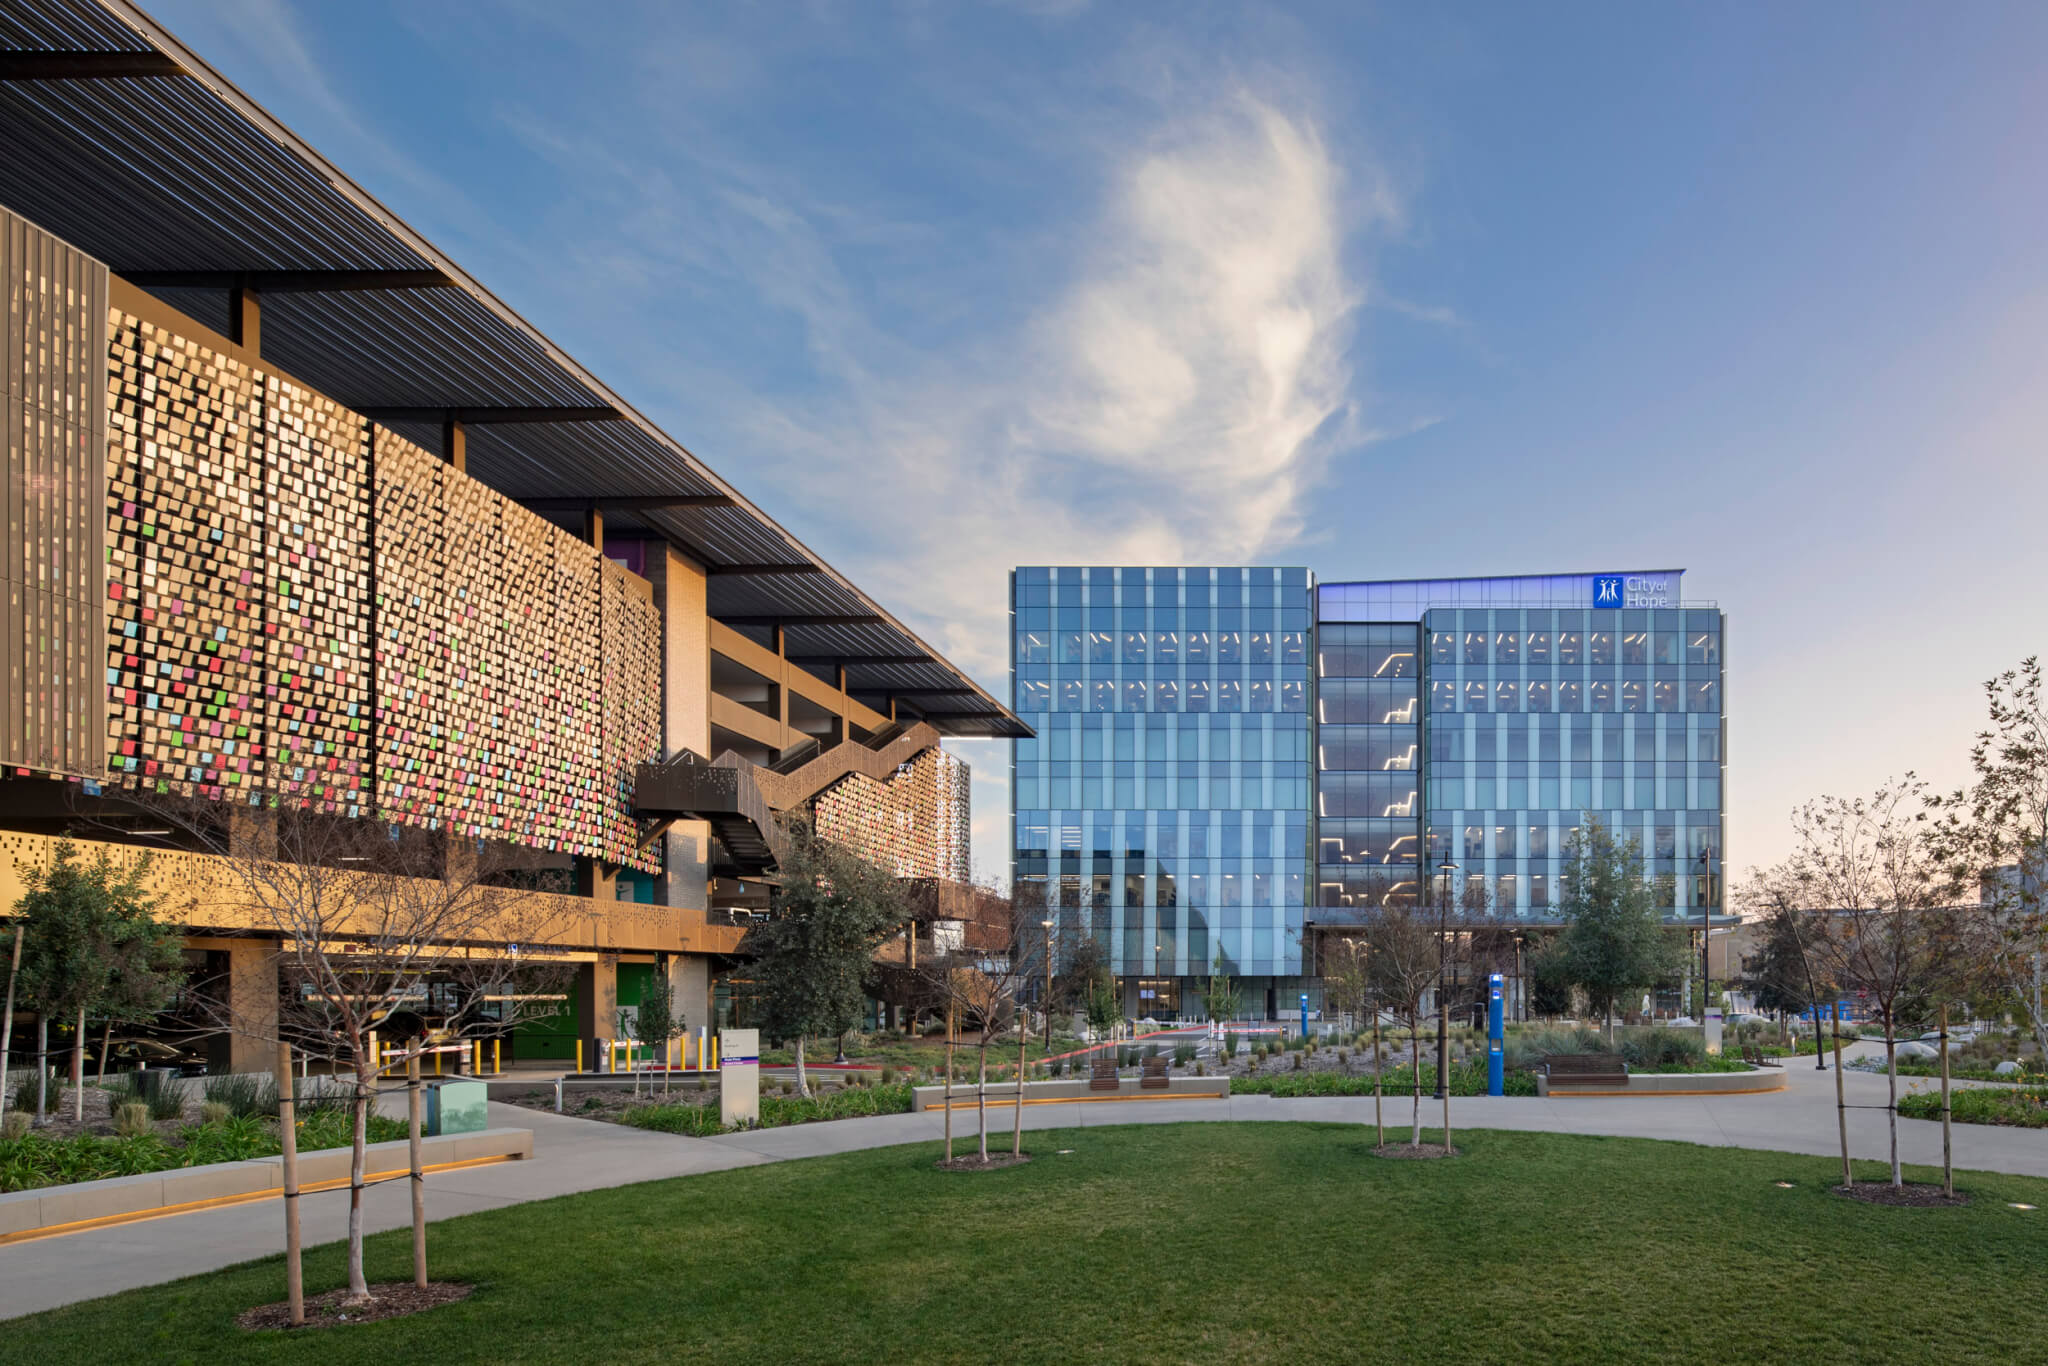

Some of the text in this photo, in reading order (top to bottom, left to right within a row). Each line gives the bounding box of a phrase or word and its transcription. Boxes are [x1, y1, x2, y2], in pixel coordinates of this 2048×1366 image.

[1626, 576, 1667, 594] City of
[1627, 592, 1667, 609] Hope
[523, 1006, 571, 1017] LEVEL 1
